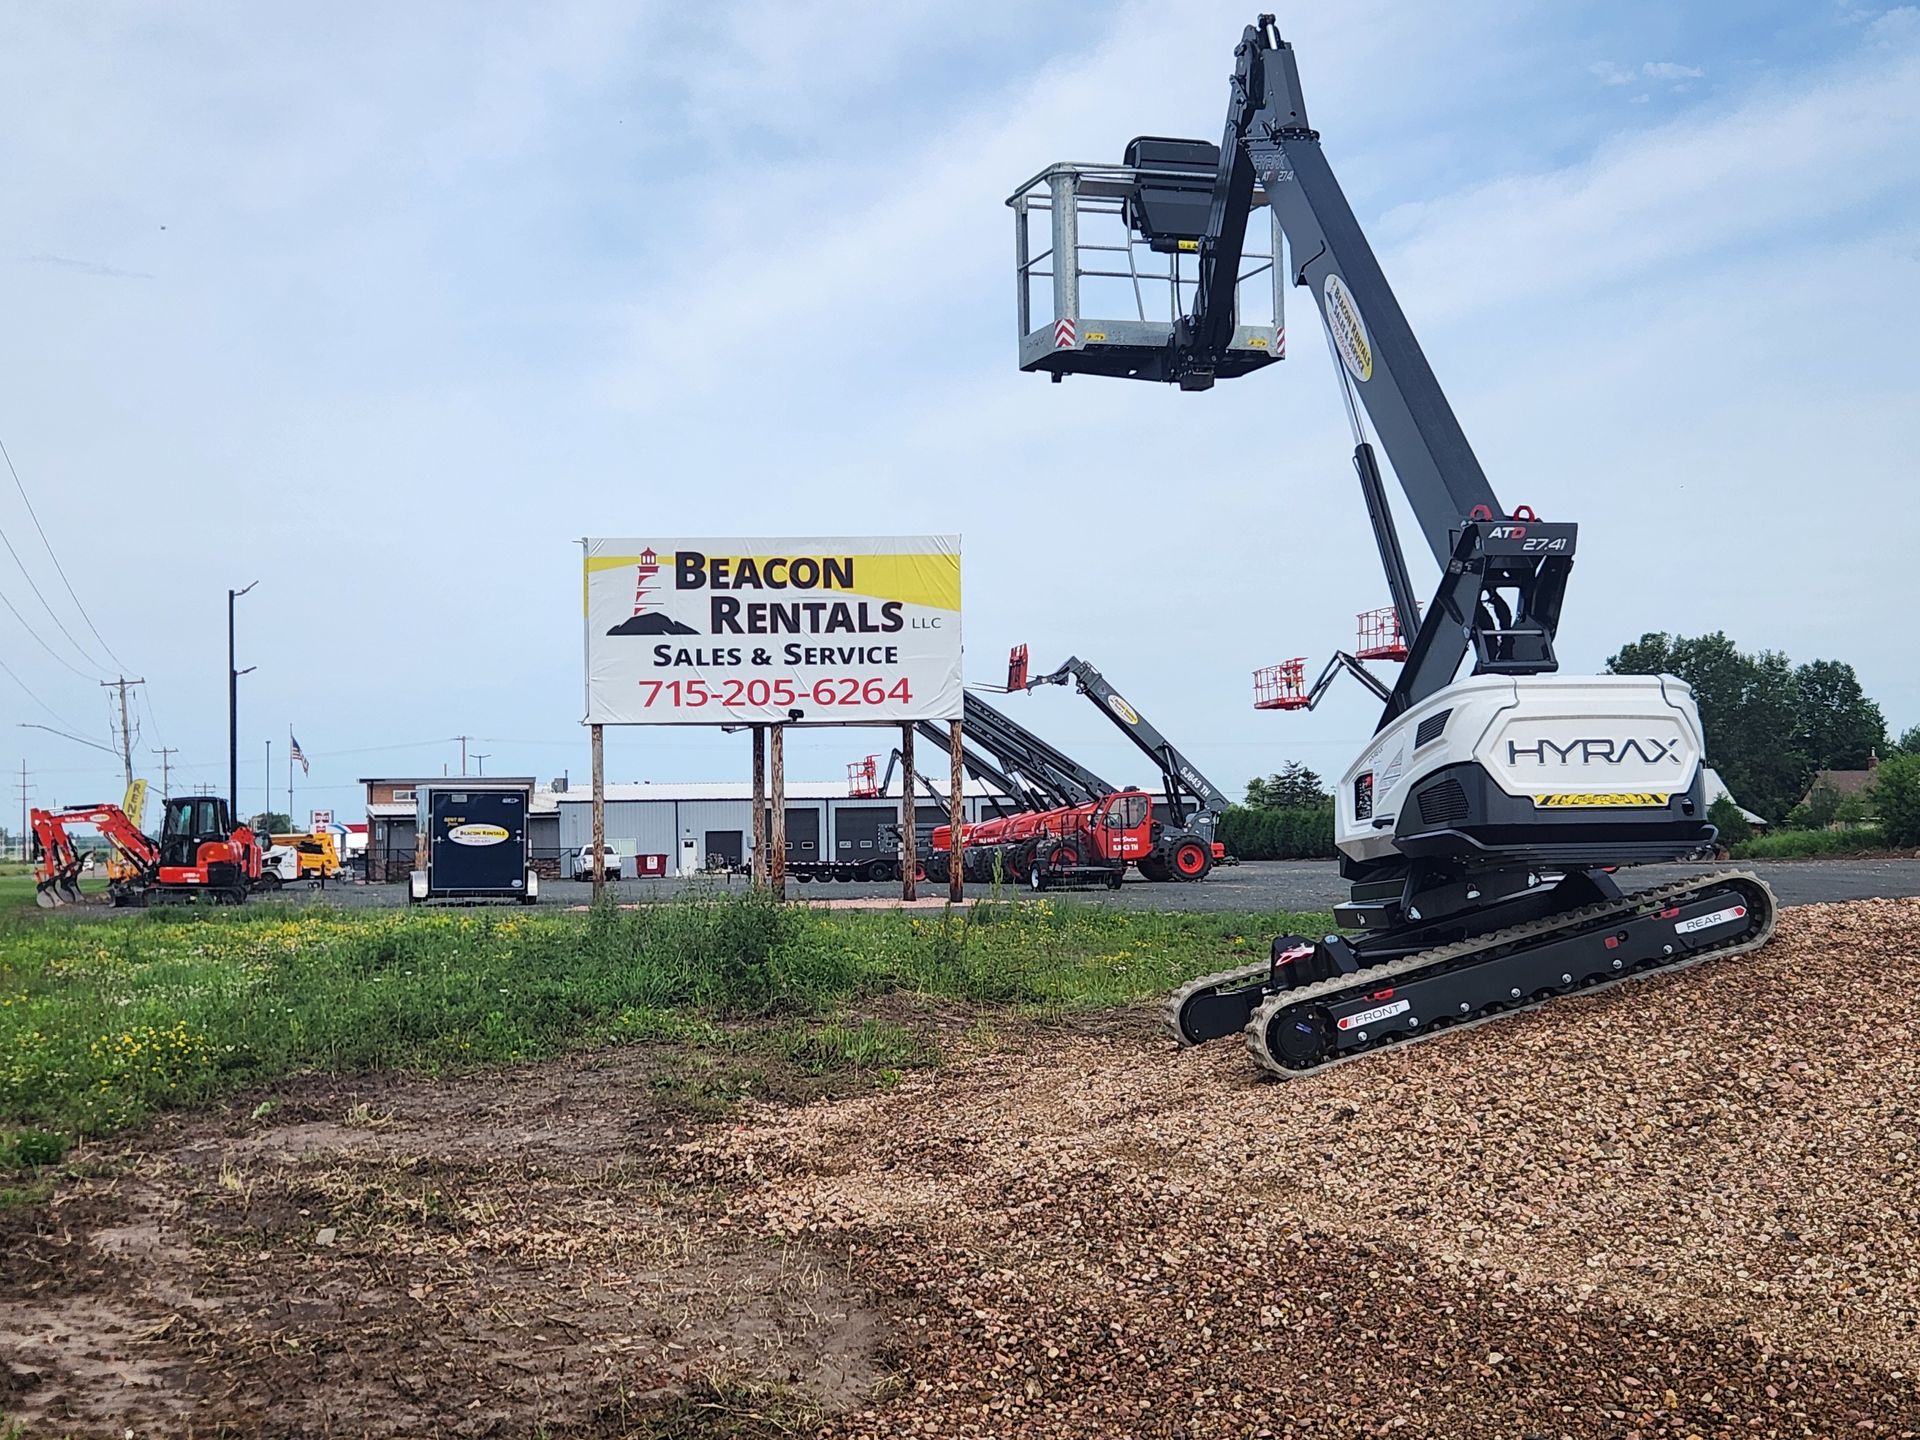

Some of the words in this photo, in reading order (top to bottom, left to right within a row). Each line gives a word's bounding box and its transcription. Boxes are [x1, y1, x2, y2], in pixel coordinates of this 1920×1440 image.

[1333, 304, 1346, 333] SALES
[1333, 286, 1353, 327] BEACON
[1350, 323, 1371, 368] RENTALS
[1522, 538, 1567, 551] 27.41
[675, 551, 854, 590] BEACON
[710, 595, 904, 635] RENTALS
[912, 617, 942, 629] LLC
[653, 644, 742, 667] SALES
[751, 647, 773, 666] &
[784, 643, 898, 666] SERVICE
[639, 677, 913, 708] 715-205-6264
[1507, 738, 1681, 765] HYRAX
[1200, 784, 1211, 797] TH
[1686, 913, 1722, 930] REAR
[1355, 1003, 1400, 1025] FRONT
